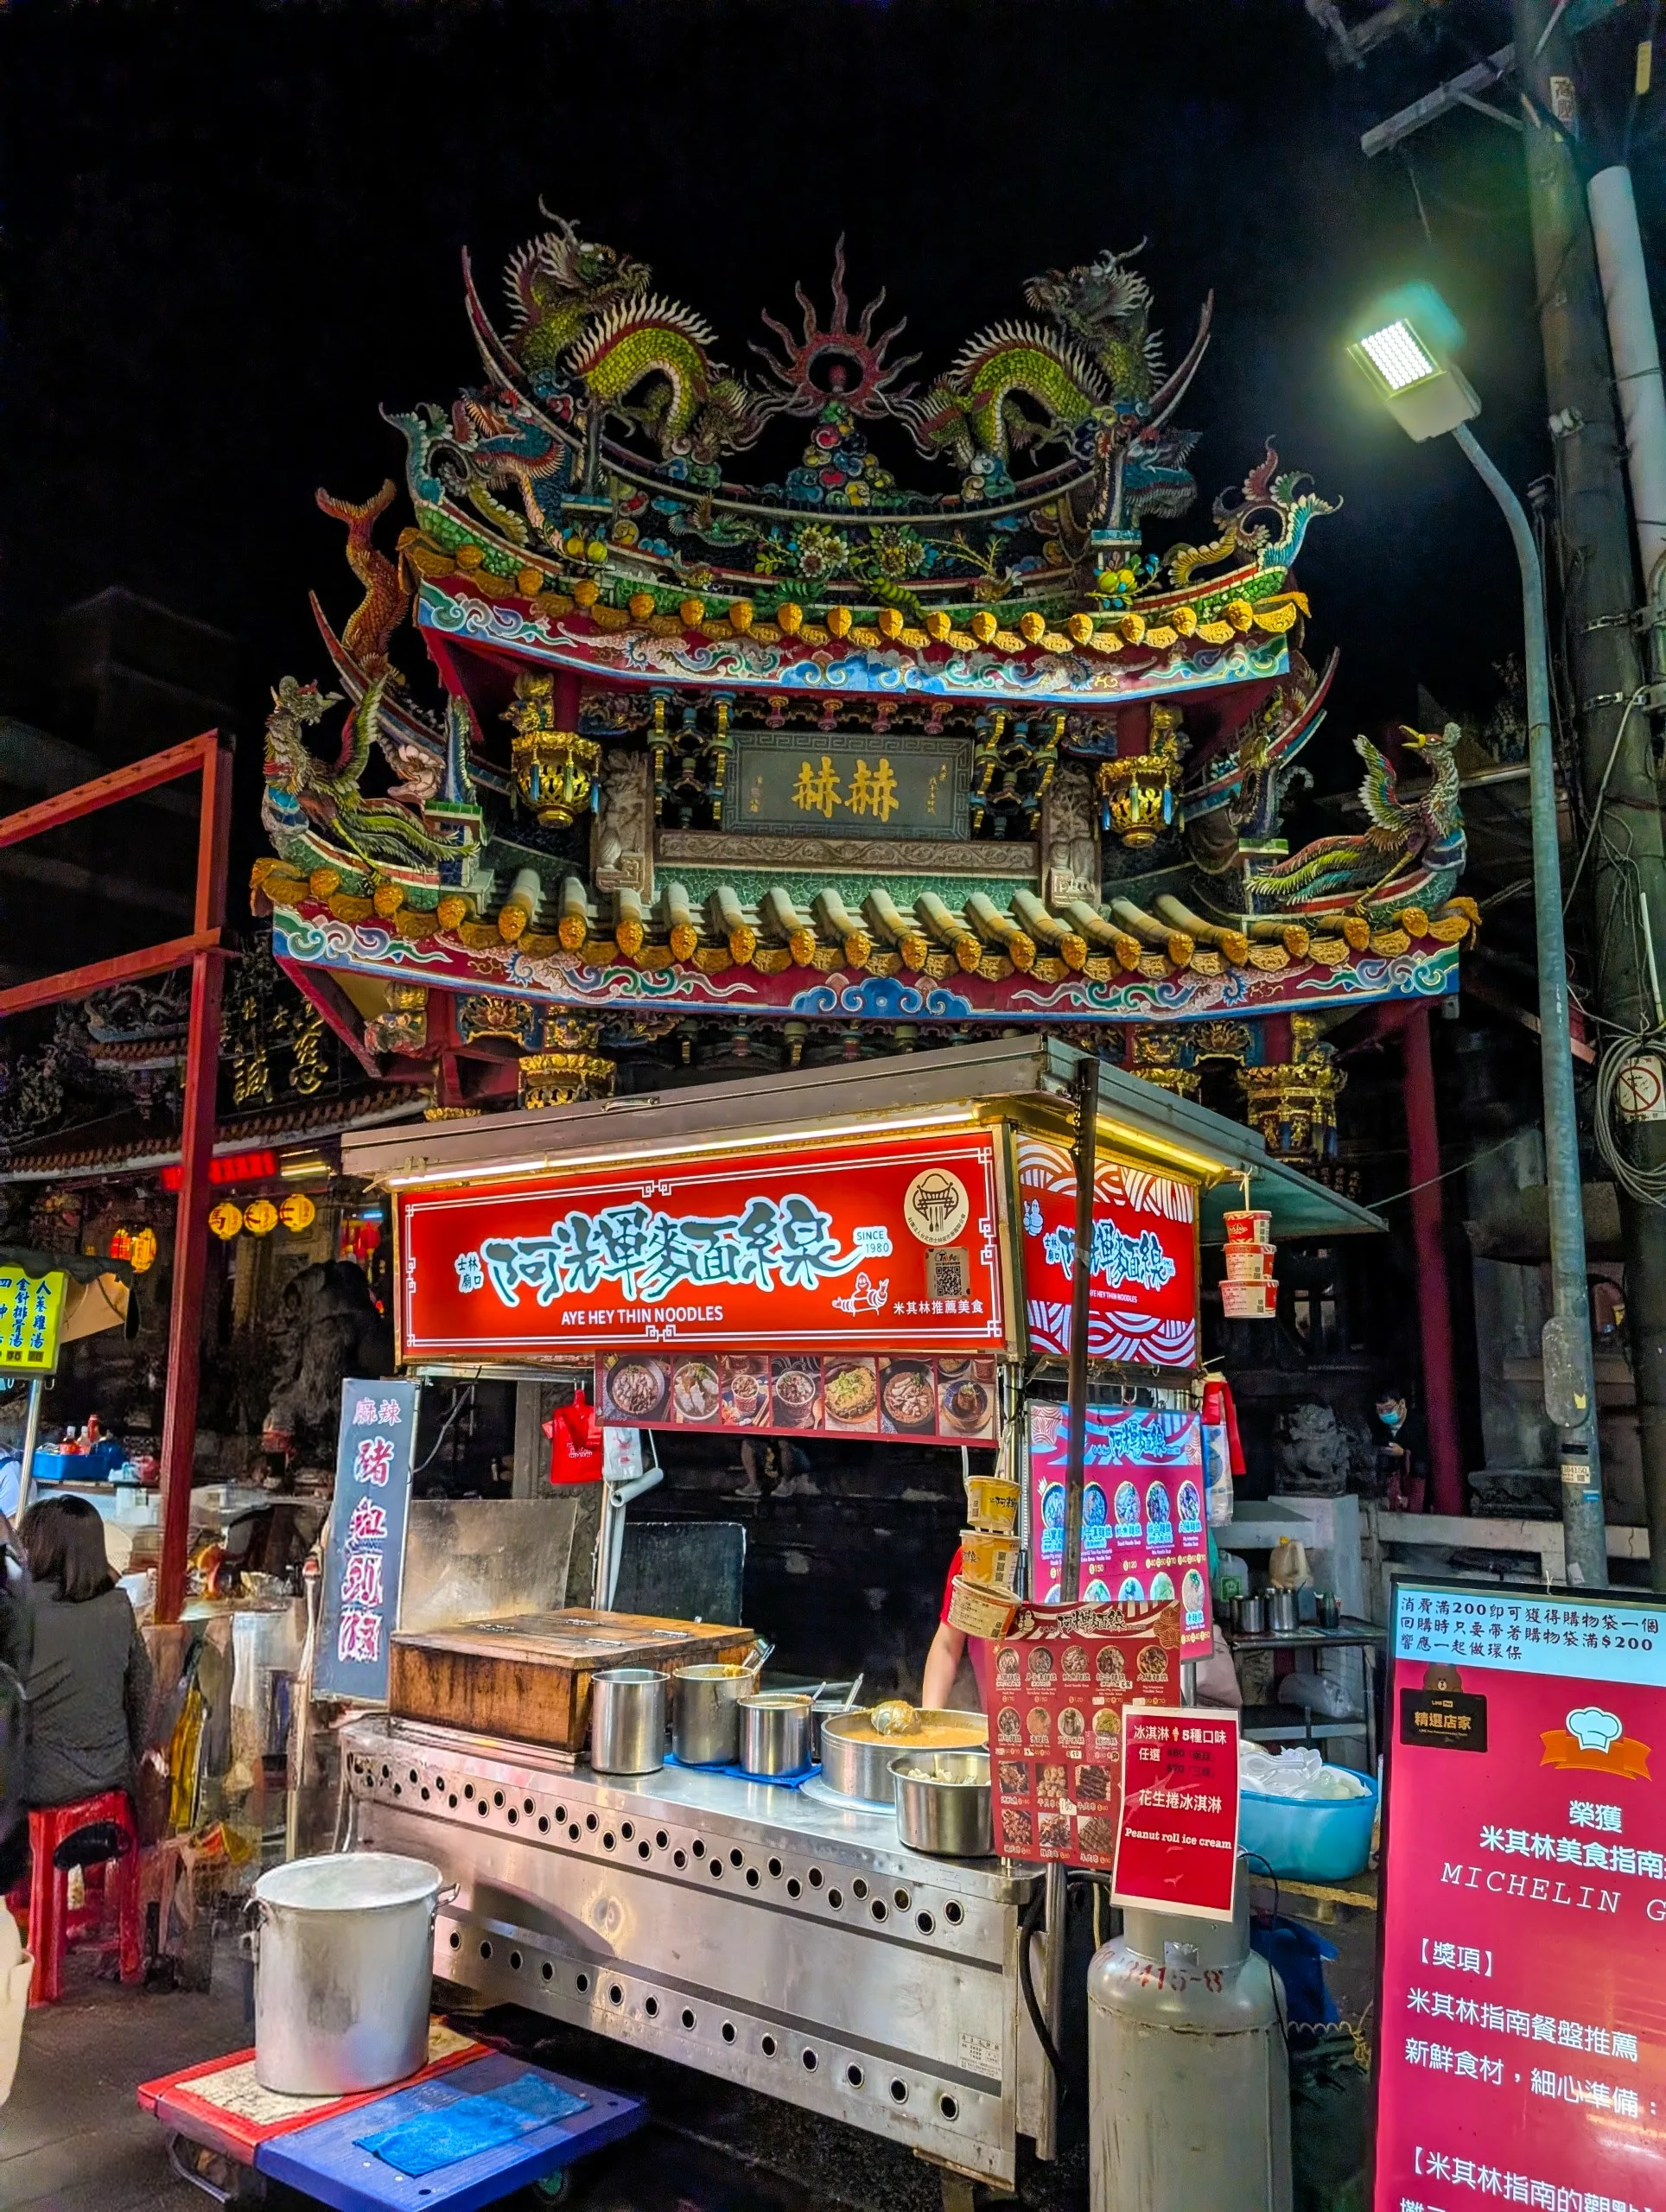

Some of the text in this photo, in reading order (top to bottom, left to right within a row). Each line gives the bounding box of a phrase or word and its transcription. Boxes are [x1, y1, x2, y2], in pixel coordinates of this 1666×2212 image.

[856, 1230, 884, 1241] SINCE
[865, 1243, 889, 1253] 1980
[458, 1256, 479, 1271] 士林
[462, 1274, 481, 1288] 廟口
[562, 1306, 723, 1325] AYE HEY THIN NOODLES
[893, 1299, 984, 1315] 米其林推薦美食
[353, 1397, 402, 1426] 麻辣
[1401, 1633, 1523, 1661] 響應一起做環保
[1415, 1712, 1472, 1730] 精選店家
[1134, 1725, 1227, 1745] 冰淇淋 5種口味
[1138, 1747, 1160, 1762] 任選
[1138, 1789, 1223, 1815] 花生捲冰淇淋
[1568, 1800, 1623, 1834] 榮獲
[1124, 1827, 1232, 1850] Peanut roll ice cream
[1479, 1825, 1666, 1880] 米其林美食指南
[1440, 1862, 1621, 1913] MICHELIN
[1407, 1987, 1638, 2063] 米其林指南餐盤推薦
